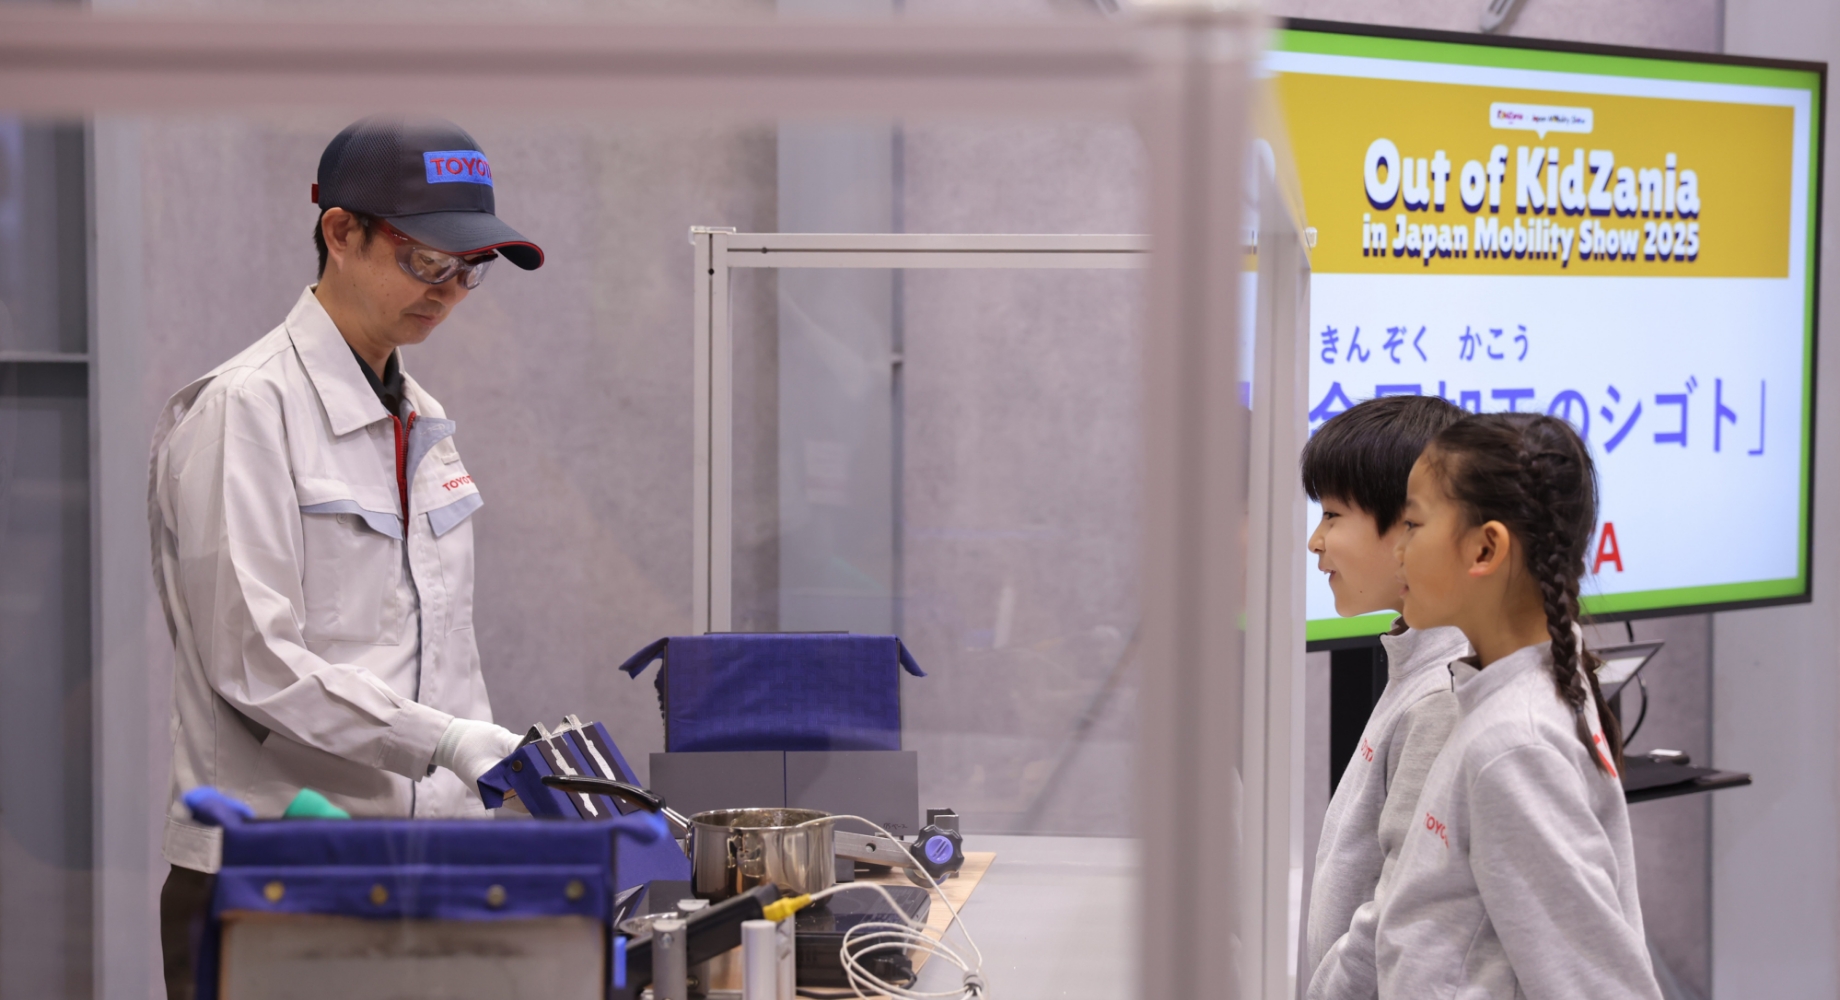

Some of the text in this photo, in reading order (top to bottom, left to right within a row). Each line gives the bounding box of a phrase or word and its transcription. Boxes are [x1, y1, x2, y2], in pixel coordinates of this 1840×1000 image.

[1364, 138, 1700, 219] Out of KidZania
[1363, 213, 1699, 268] in Japan Mobility Show 2025
